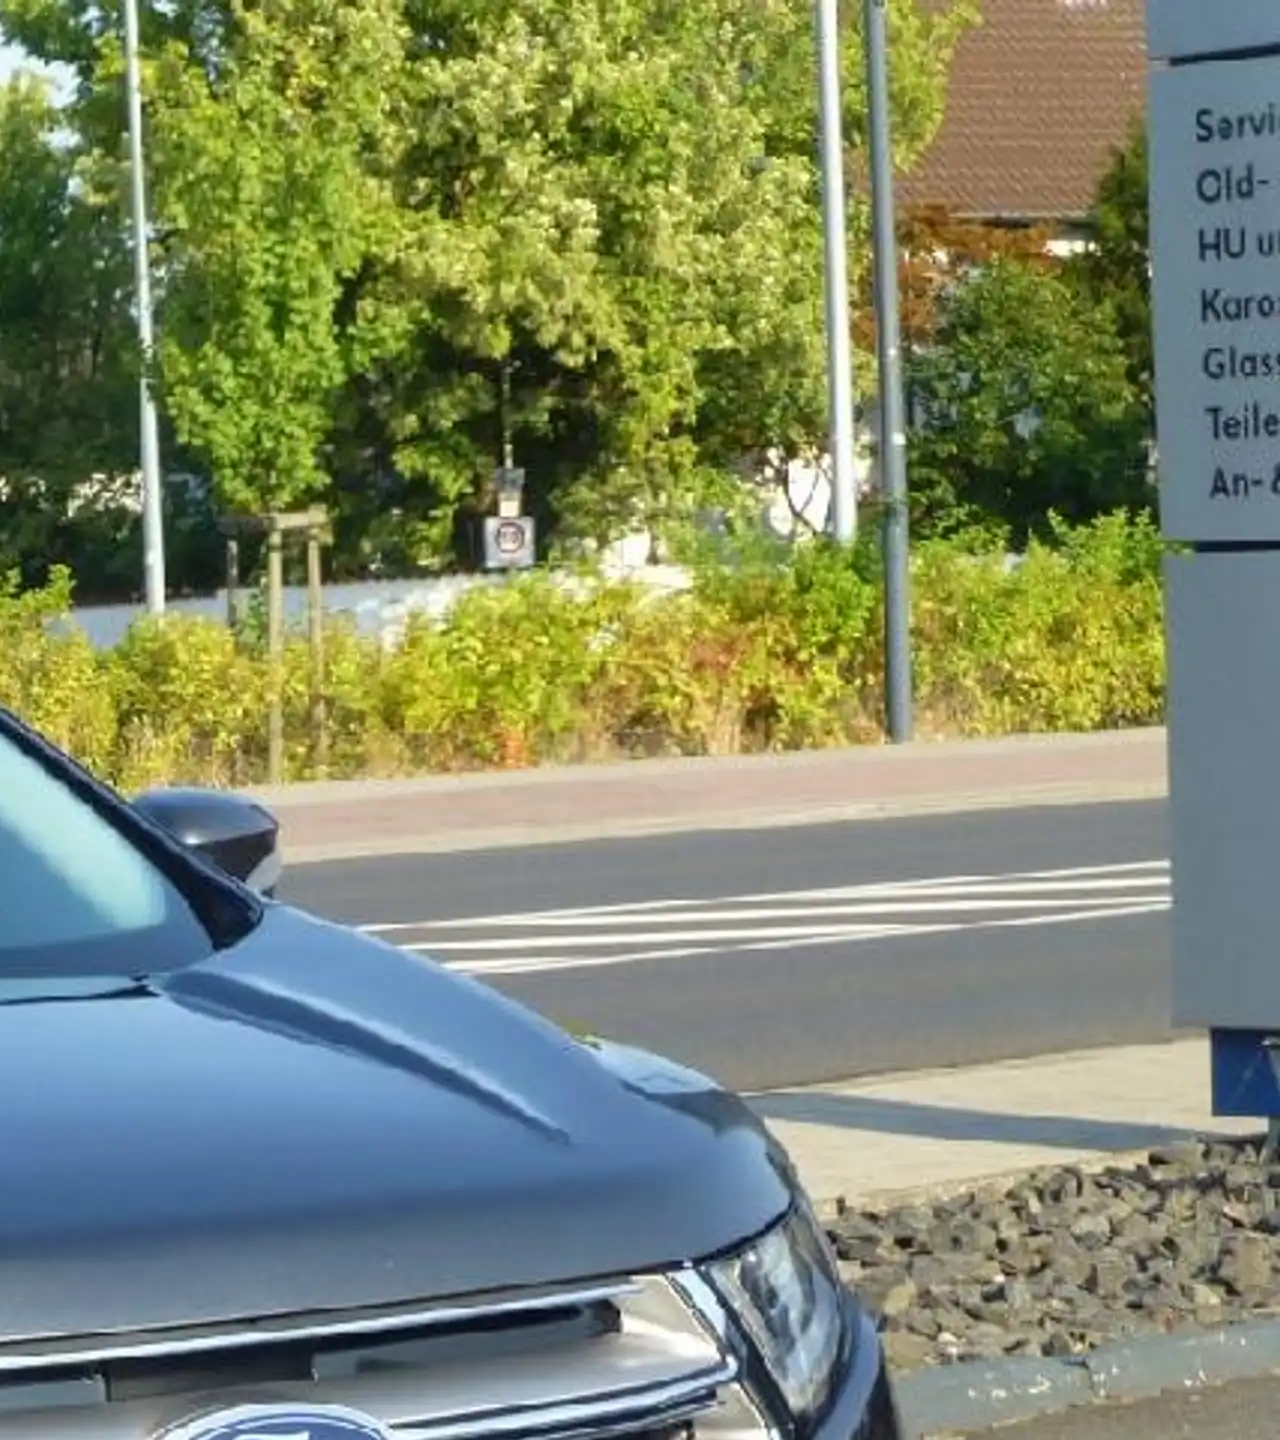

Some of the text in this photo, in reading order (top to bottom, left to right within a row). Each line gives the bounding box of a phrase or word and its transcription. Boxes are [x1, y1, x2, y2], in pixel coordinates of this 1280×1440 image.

[1195, 102, 1280, 142] Servi
[1196, 163, 1269, 204] Old-
[1198, 226, 1280, 262] HU u
[1200, 287, 1280, 323] Karo
[1204, 402, 1280, 441] Teile
[1209, 466, 1264, 499] An-
